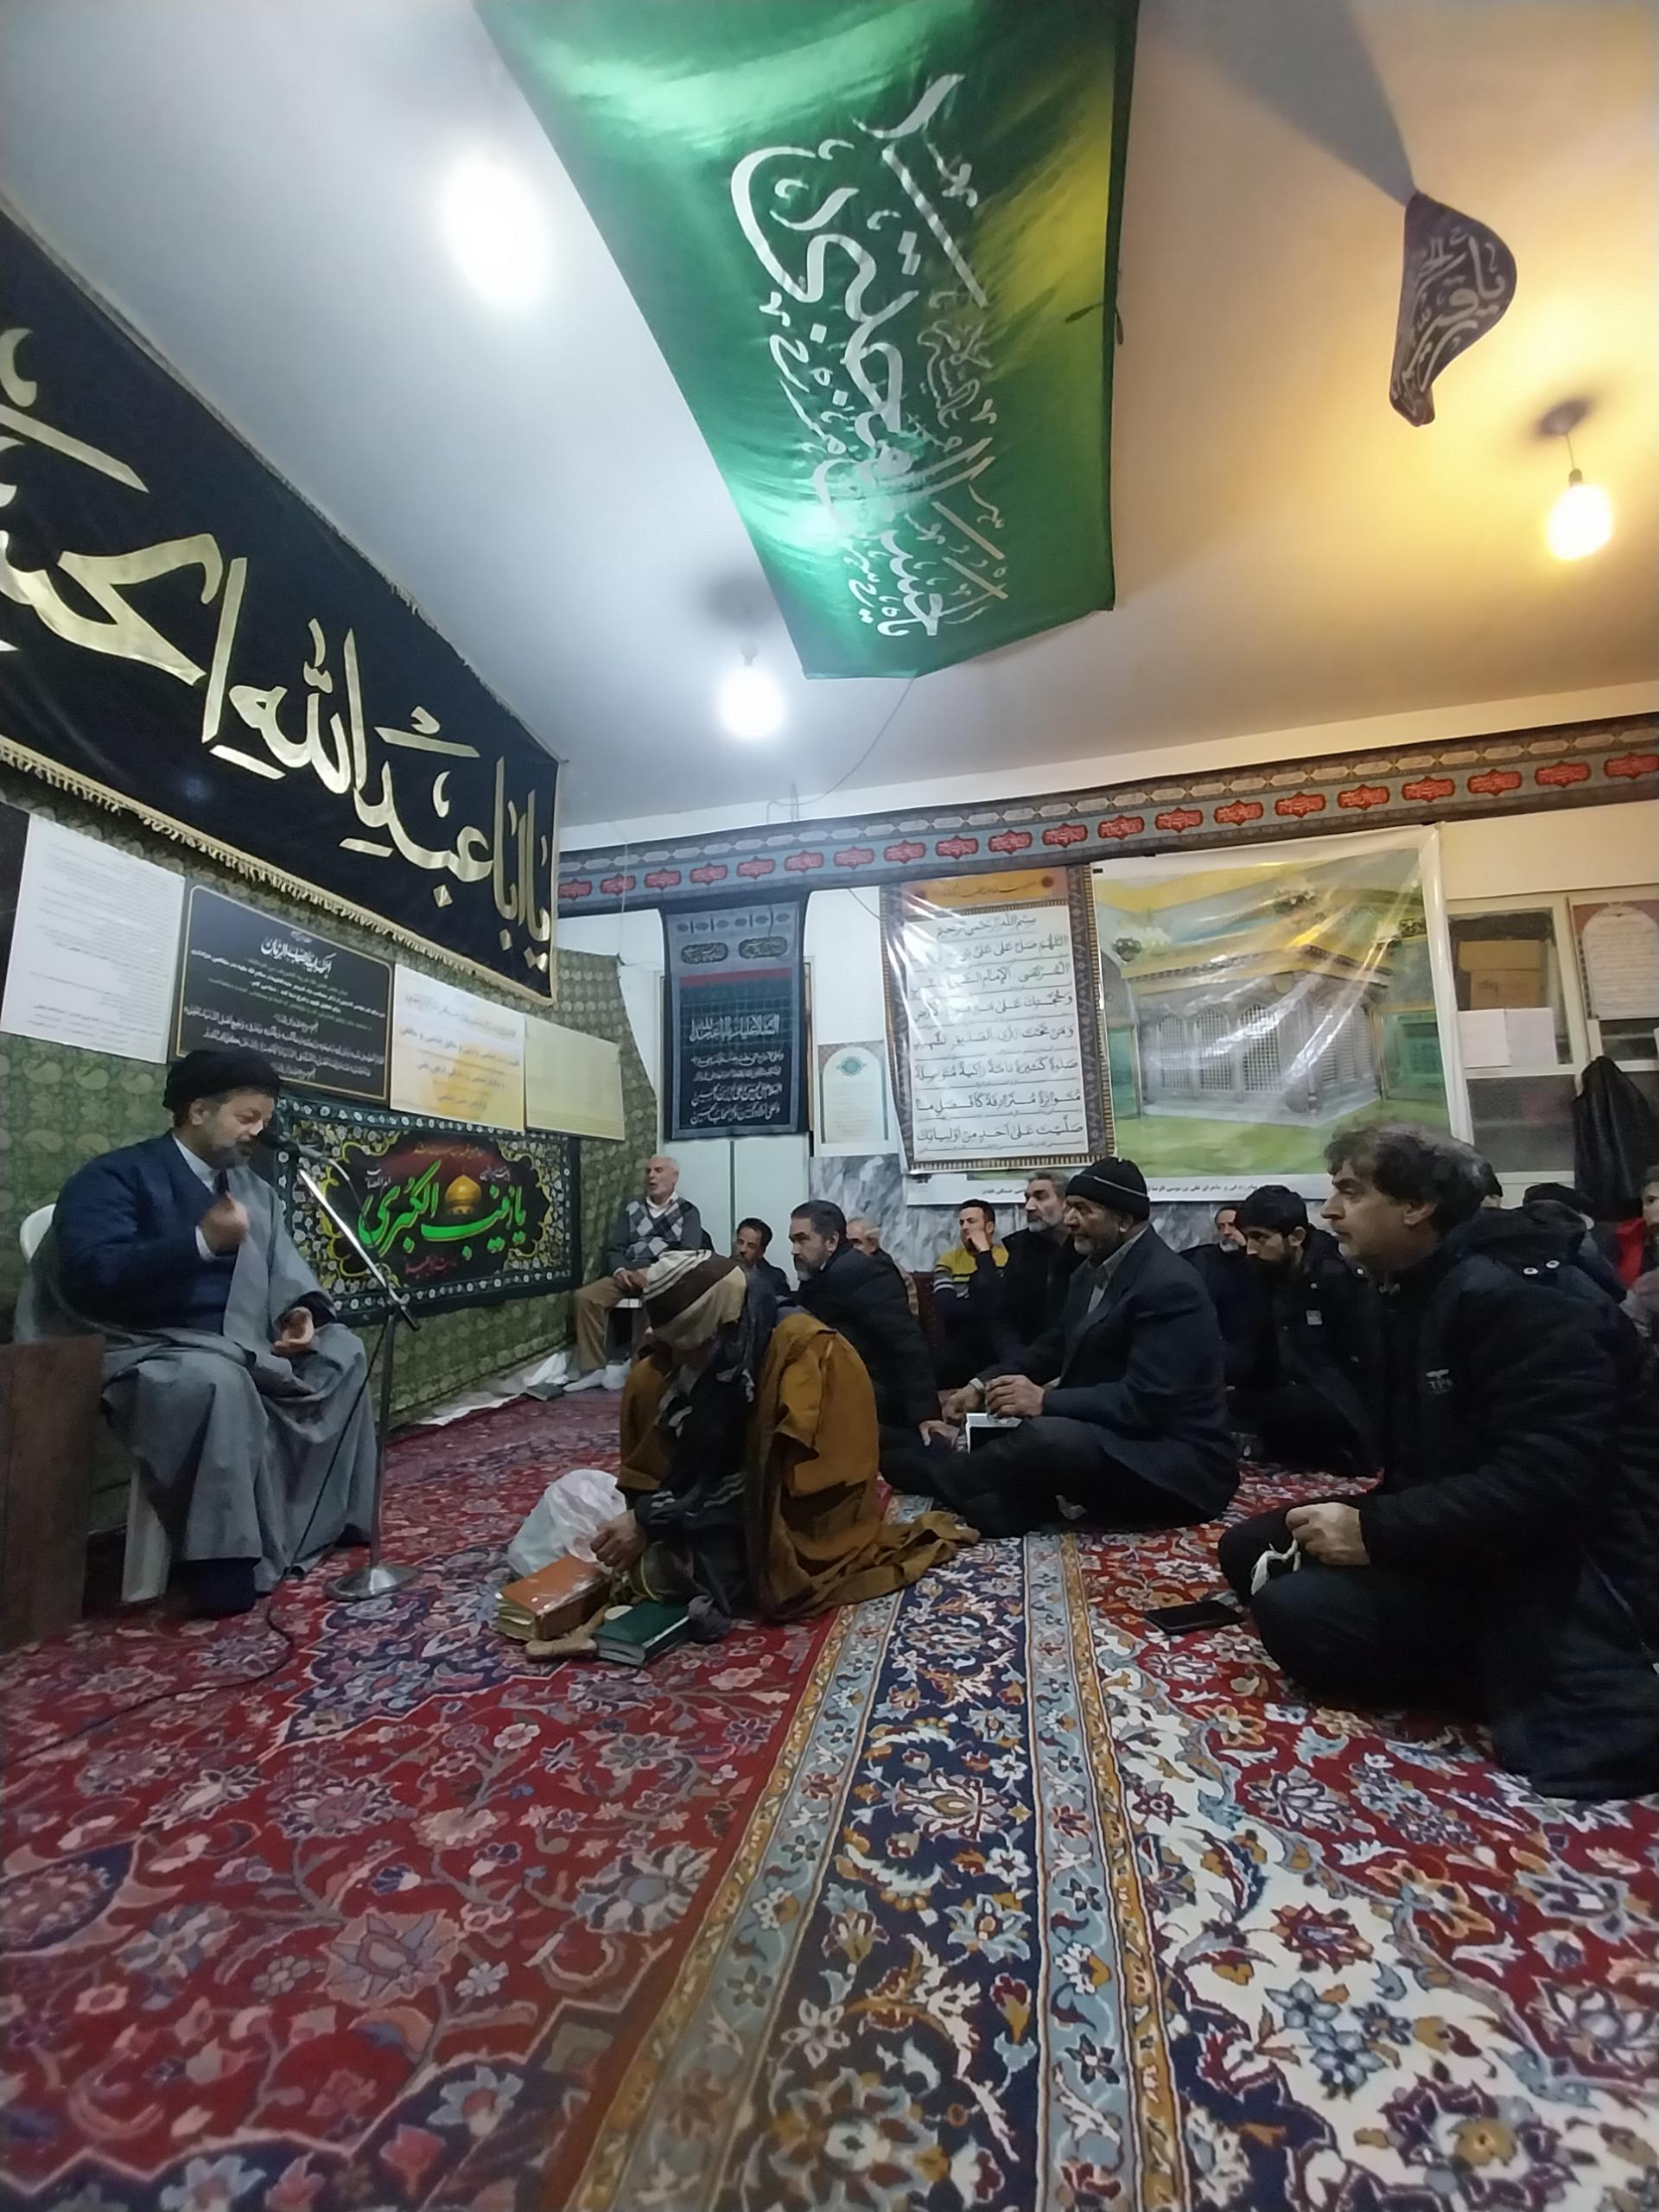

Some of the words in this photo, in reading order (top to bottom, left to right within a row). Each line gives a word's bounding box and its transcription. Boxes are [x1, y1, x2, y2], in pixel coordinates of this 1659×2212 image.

[358, 1160, 442, 1258] الکبری
[421, 1185, 516, 1262] زینب
[512, 1186, 526, 1245] یا
